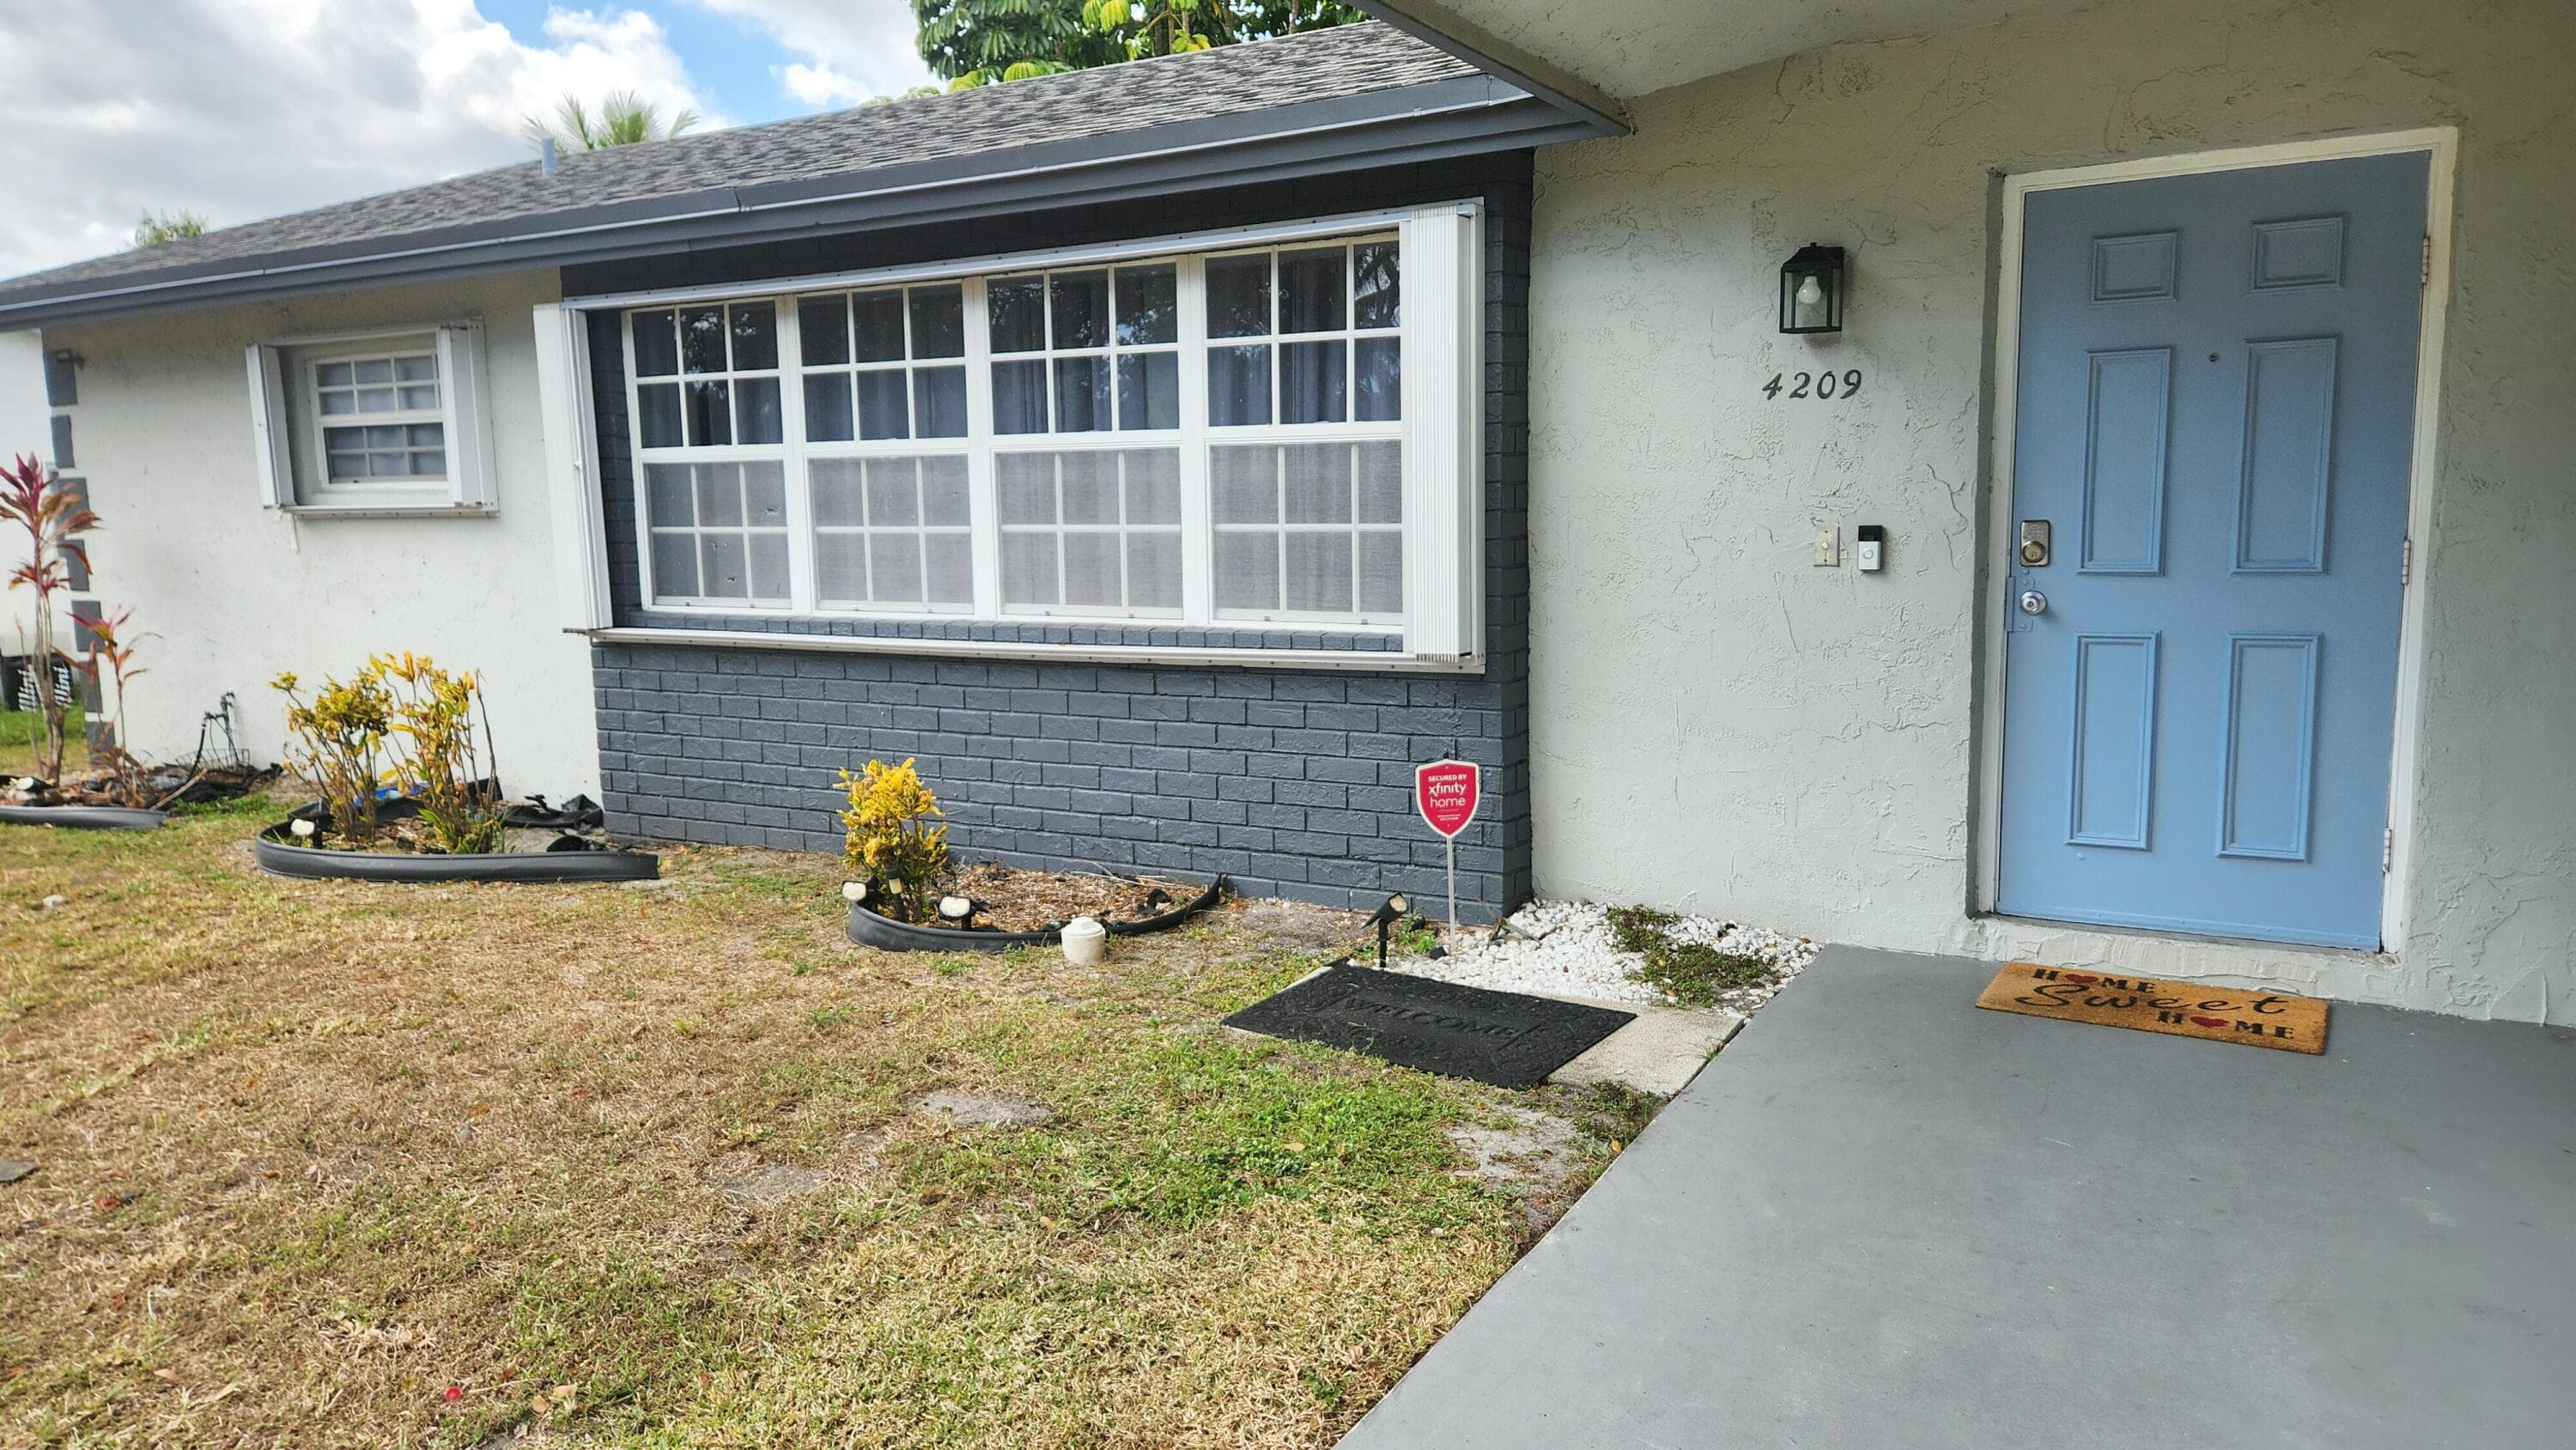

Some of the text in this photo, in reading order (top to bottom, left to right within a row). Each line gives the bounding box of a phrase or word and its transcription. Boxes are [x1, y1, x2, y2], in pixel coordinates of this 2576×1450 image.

[1762, 369, 1862, 400] 4209
[1429, 782, 1467, 797] xfinity
[1430, 797, 1466, 808] home
[2014, 984, 2288, 1014] Sweet
